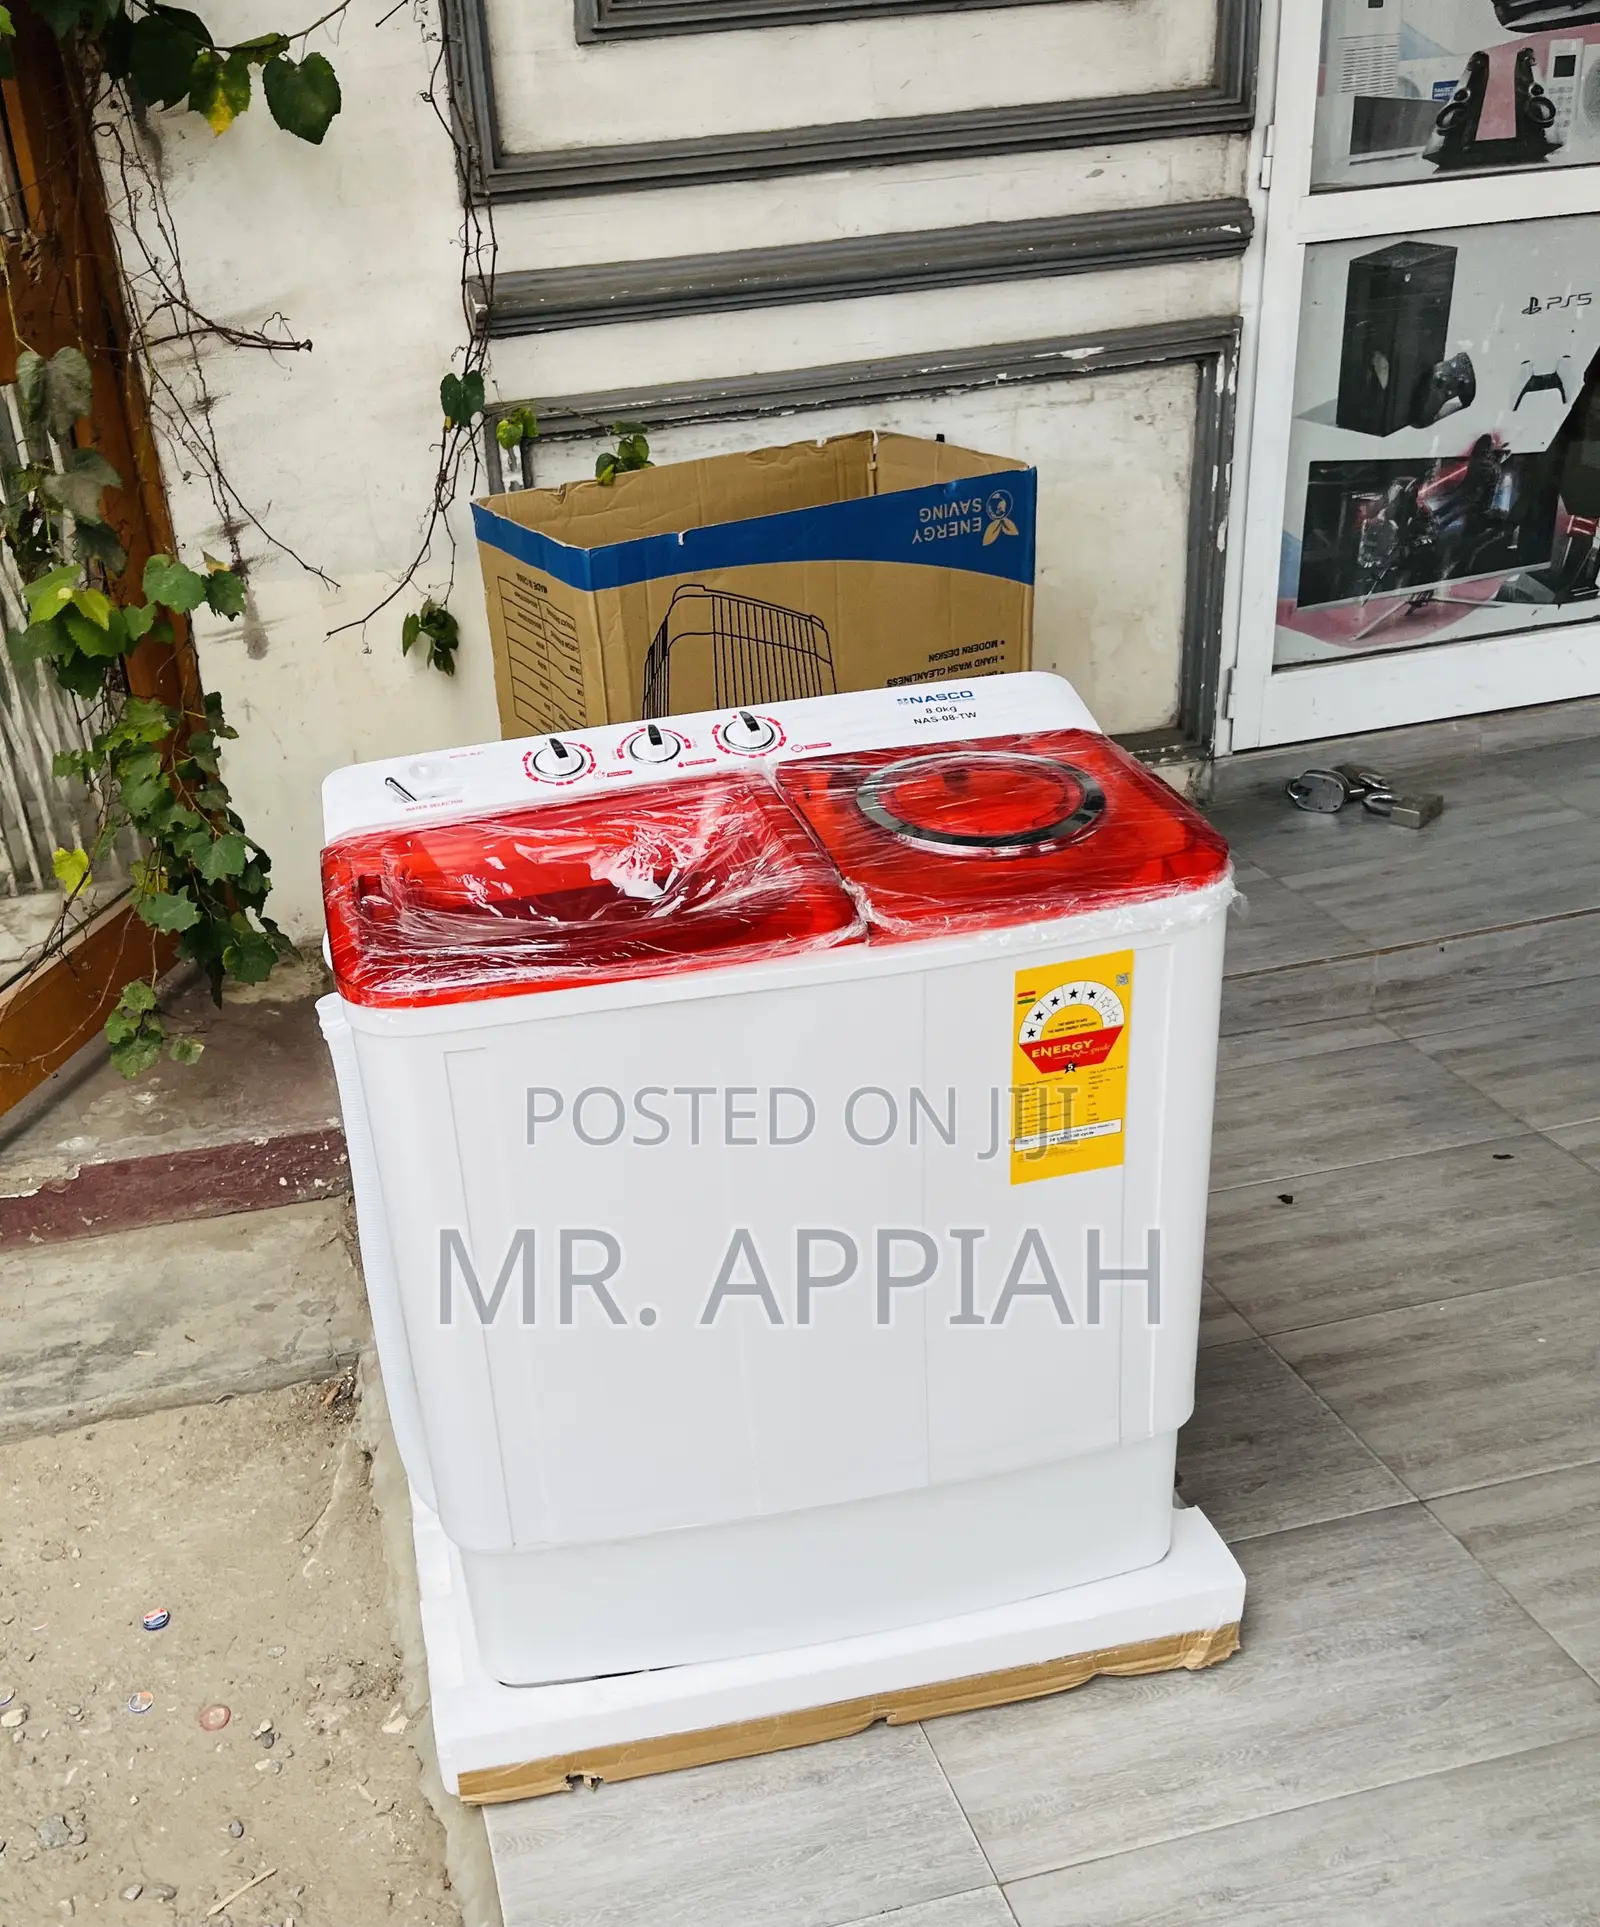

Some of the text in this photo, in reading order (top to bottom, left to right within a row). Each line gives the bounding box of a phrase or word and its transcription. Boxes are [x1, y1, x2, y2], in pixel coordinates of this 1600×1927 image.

[1546, 292, 1592, 310] PS5
[919, 498, 982, 522] SAVING
[912, 516, 982, 544] ENERGY
[928, 640, 998, 662] MODERN DESIGN
[886, 655, 998, 688] HAND WASH CLEANLINESS
[910, 690, 974, 704] NASCO
[914, 712, 976, 724] NAS-08-TW
[1032, 1039, 1094, 1058] ENERGY
